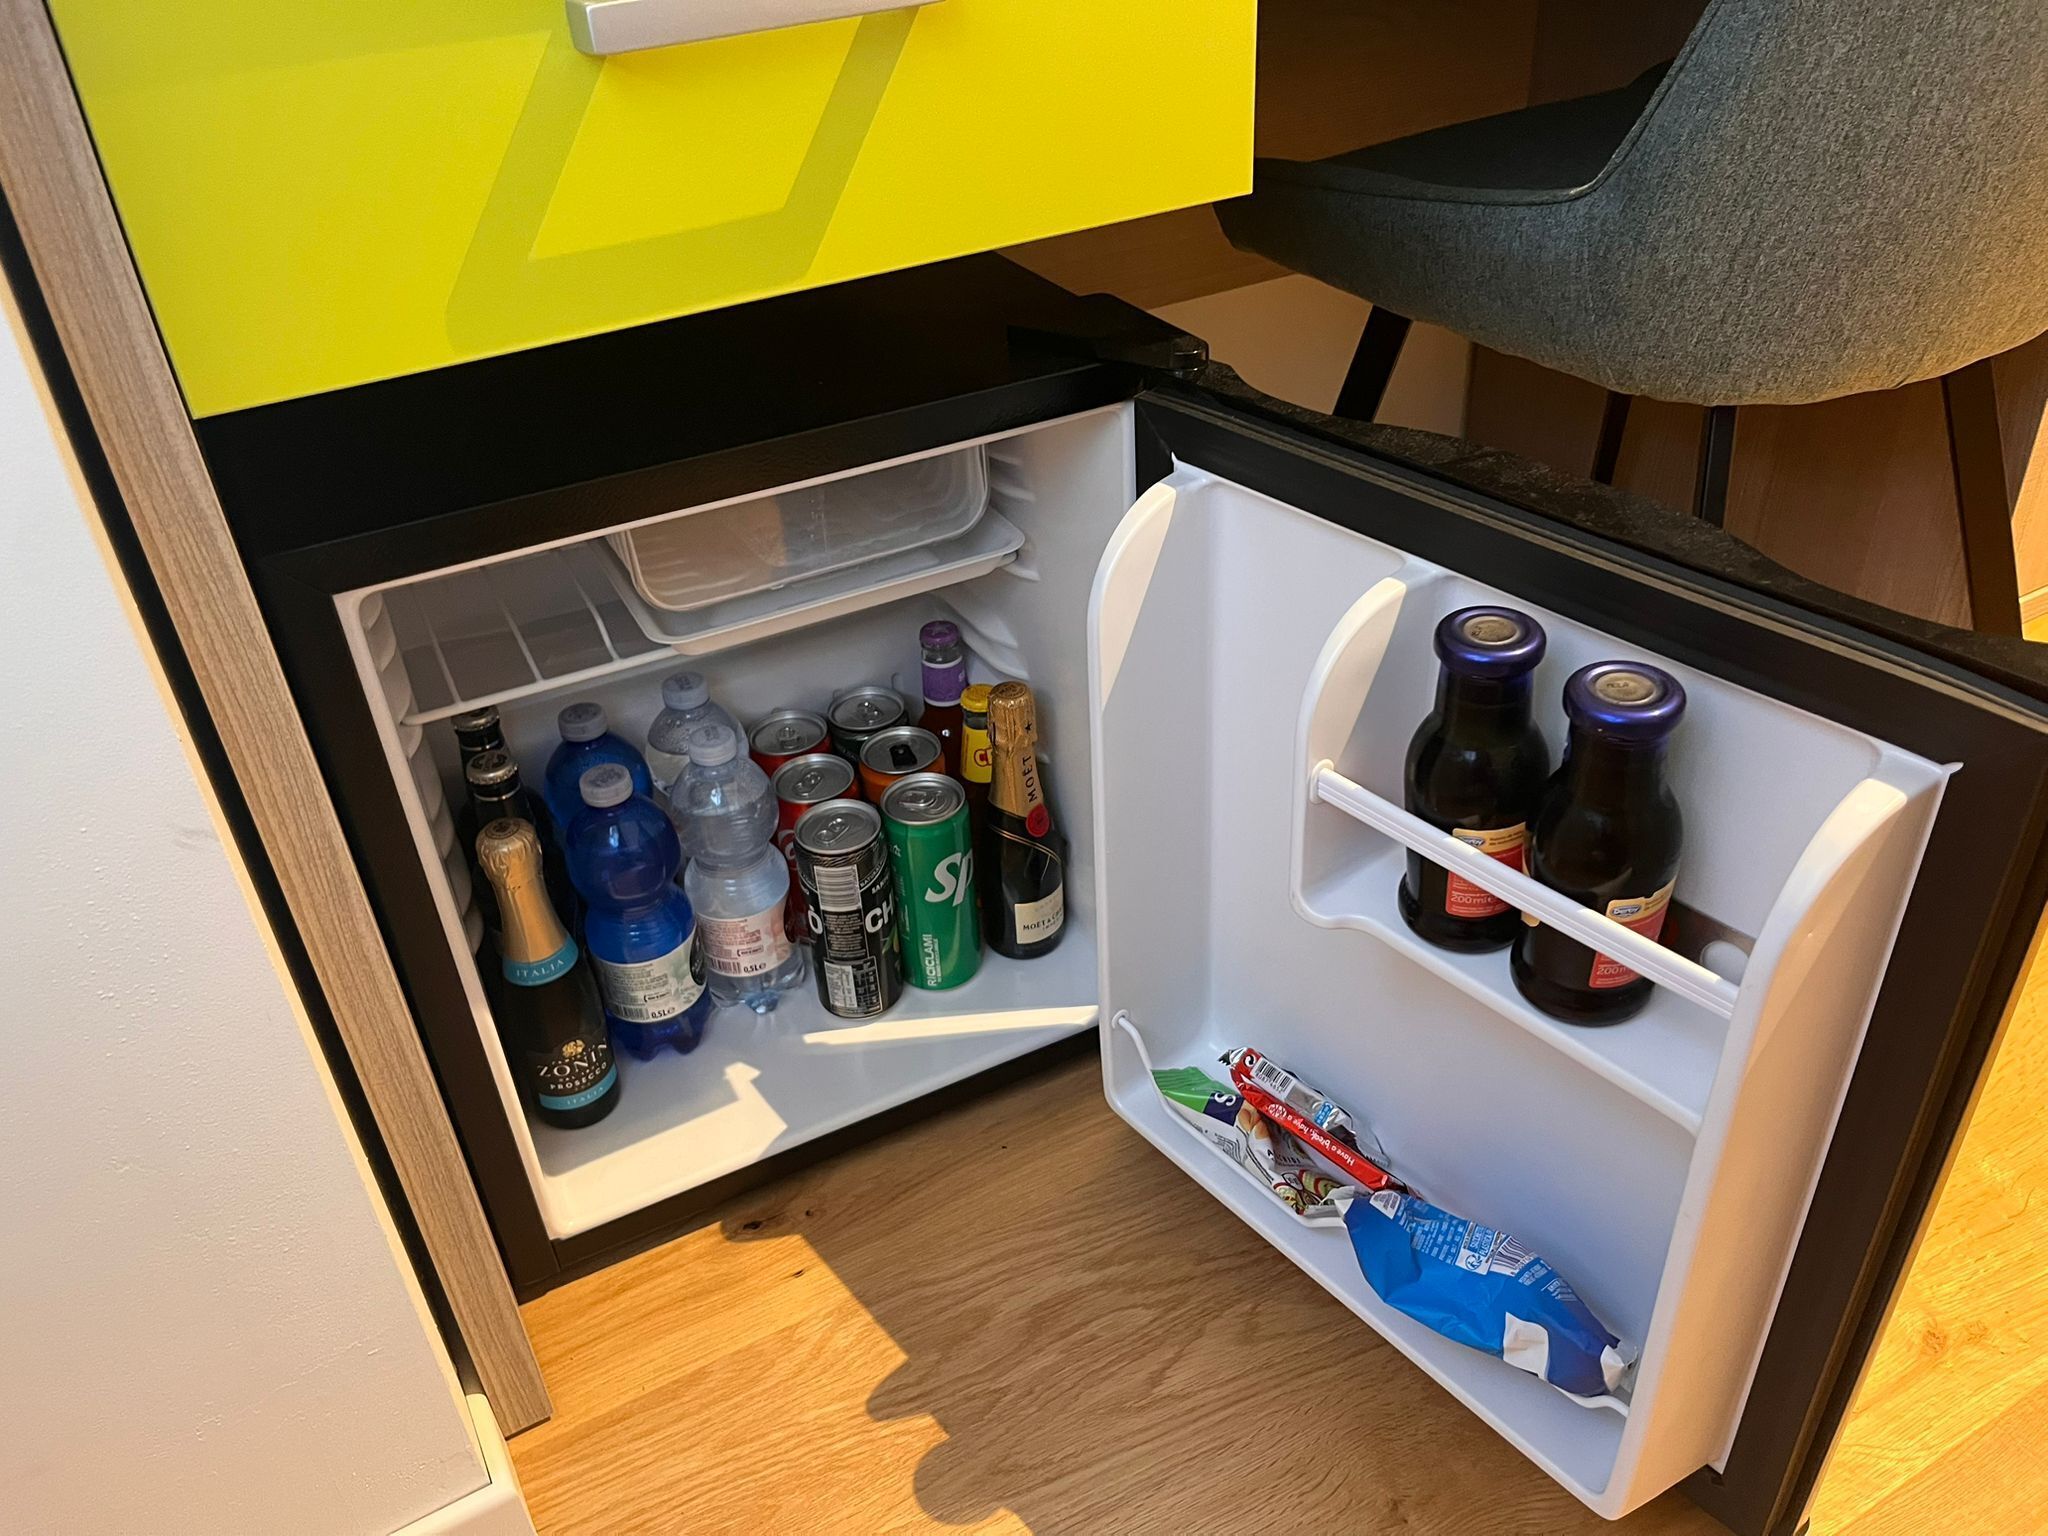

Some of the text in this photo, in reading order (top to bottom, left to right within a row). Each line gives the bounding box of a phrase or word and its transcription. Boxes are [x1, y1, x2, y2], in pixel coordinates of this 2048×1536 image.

[515, 959, 565, 978] ITALIA
[922, 934, 938, 987] RICICLAMI
[550, 1061, 607, 1090] PROSECCO
[1292, 1118, 1310, 1135] have
[1336, 1148, 1355, 1166] Have
